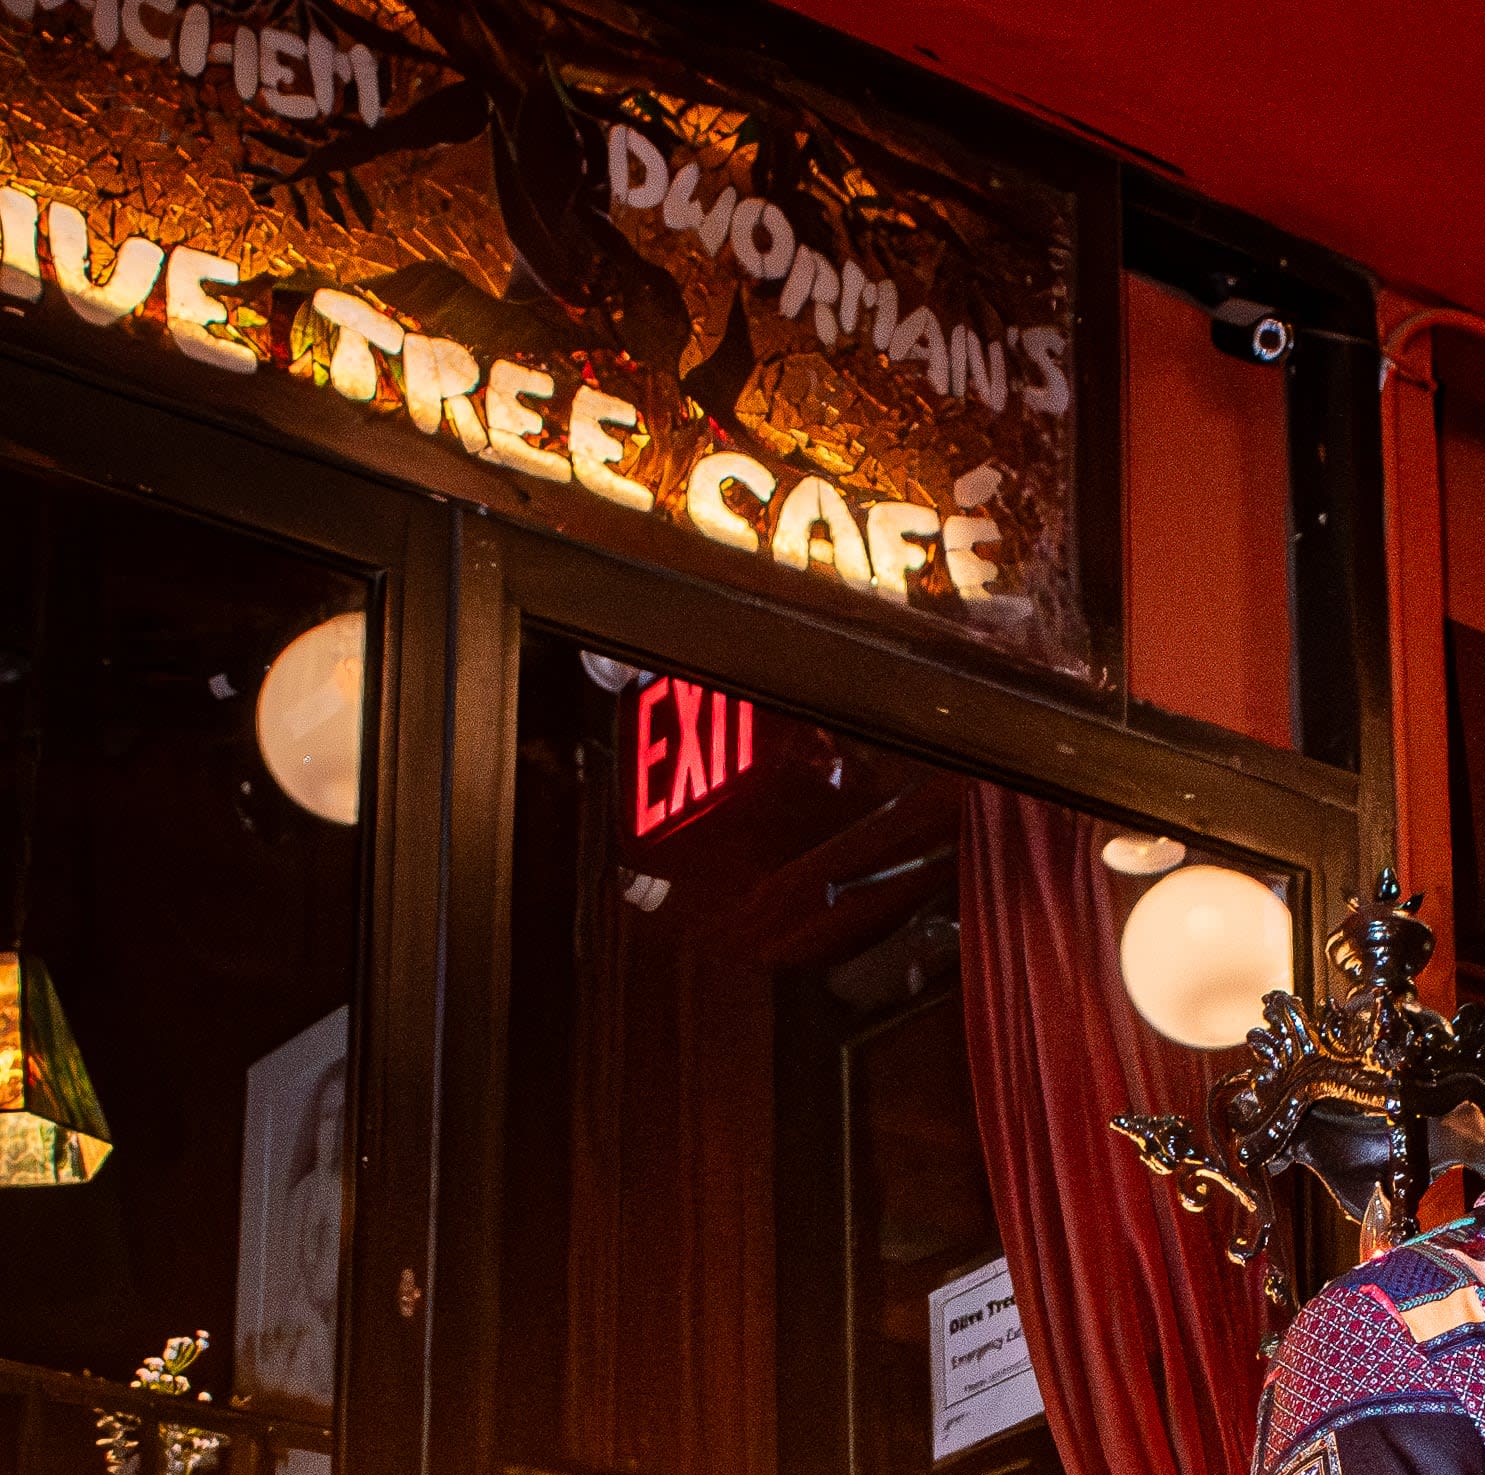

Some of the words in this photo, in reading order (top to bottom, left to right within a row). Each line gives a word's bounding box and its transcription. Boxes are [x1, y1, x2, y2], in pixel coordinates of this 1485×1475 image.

[0, 185, 258, 374] IVE
[313, 288, 654, 513] TREE
[607, 124, 1070, 415] DWORMAN'S
